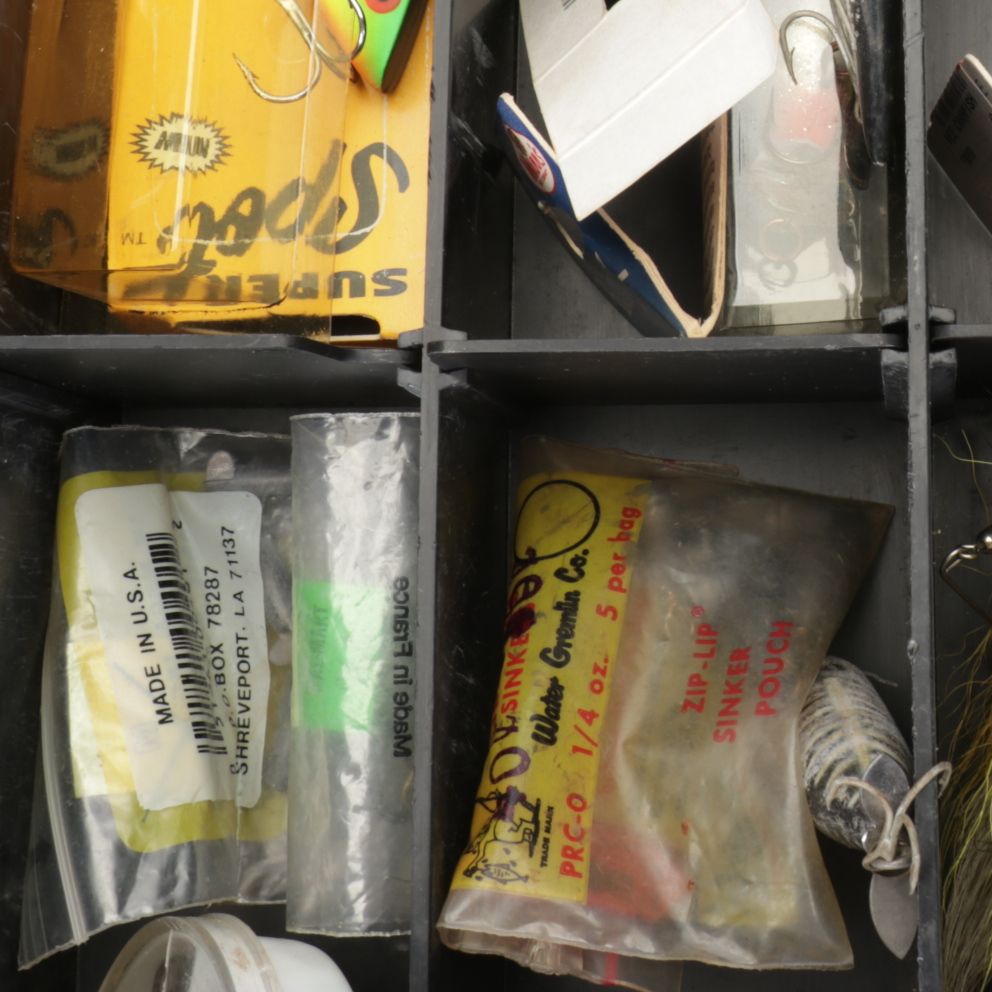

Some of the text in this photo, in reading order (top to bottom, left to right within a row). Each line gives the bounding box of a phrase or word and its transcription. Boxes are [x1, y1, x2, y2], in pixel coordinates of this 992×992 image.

[207, 267, 409, 306] SUPER
[607, 506, 642, 544] bag
[220, 525, 243, 580] 71137
[607, 551, 629, 595] per
[203, 565, 223, 629] 78287
[233, 589, 246, 617] LA
[596, 604, 618, 621] 5
[123, 561, 175, 726] MADE IN U.S.A.
[530, 547, 591, 747] Water Gremlin Co.
[590, 654, 610, 696] oz.
[754, 618, 794, 719] POUCH
[713, 646, 752, 744] SINKER
[571, 708, 599, 758] 1/4
[539, 837, 552, 870] TRADE
